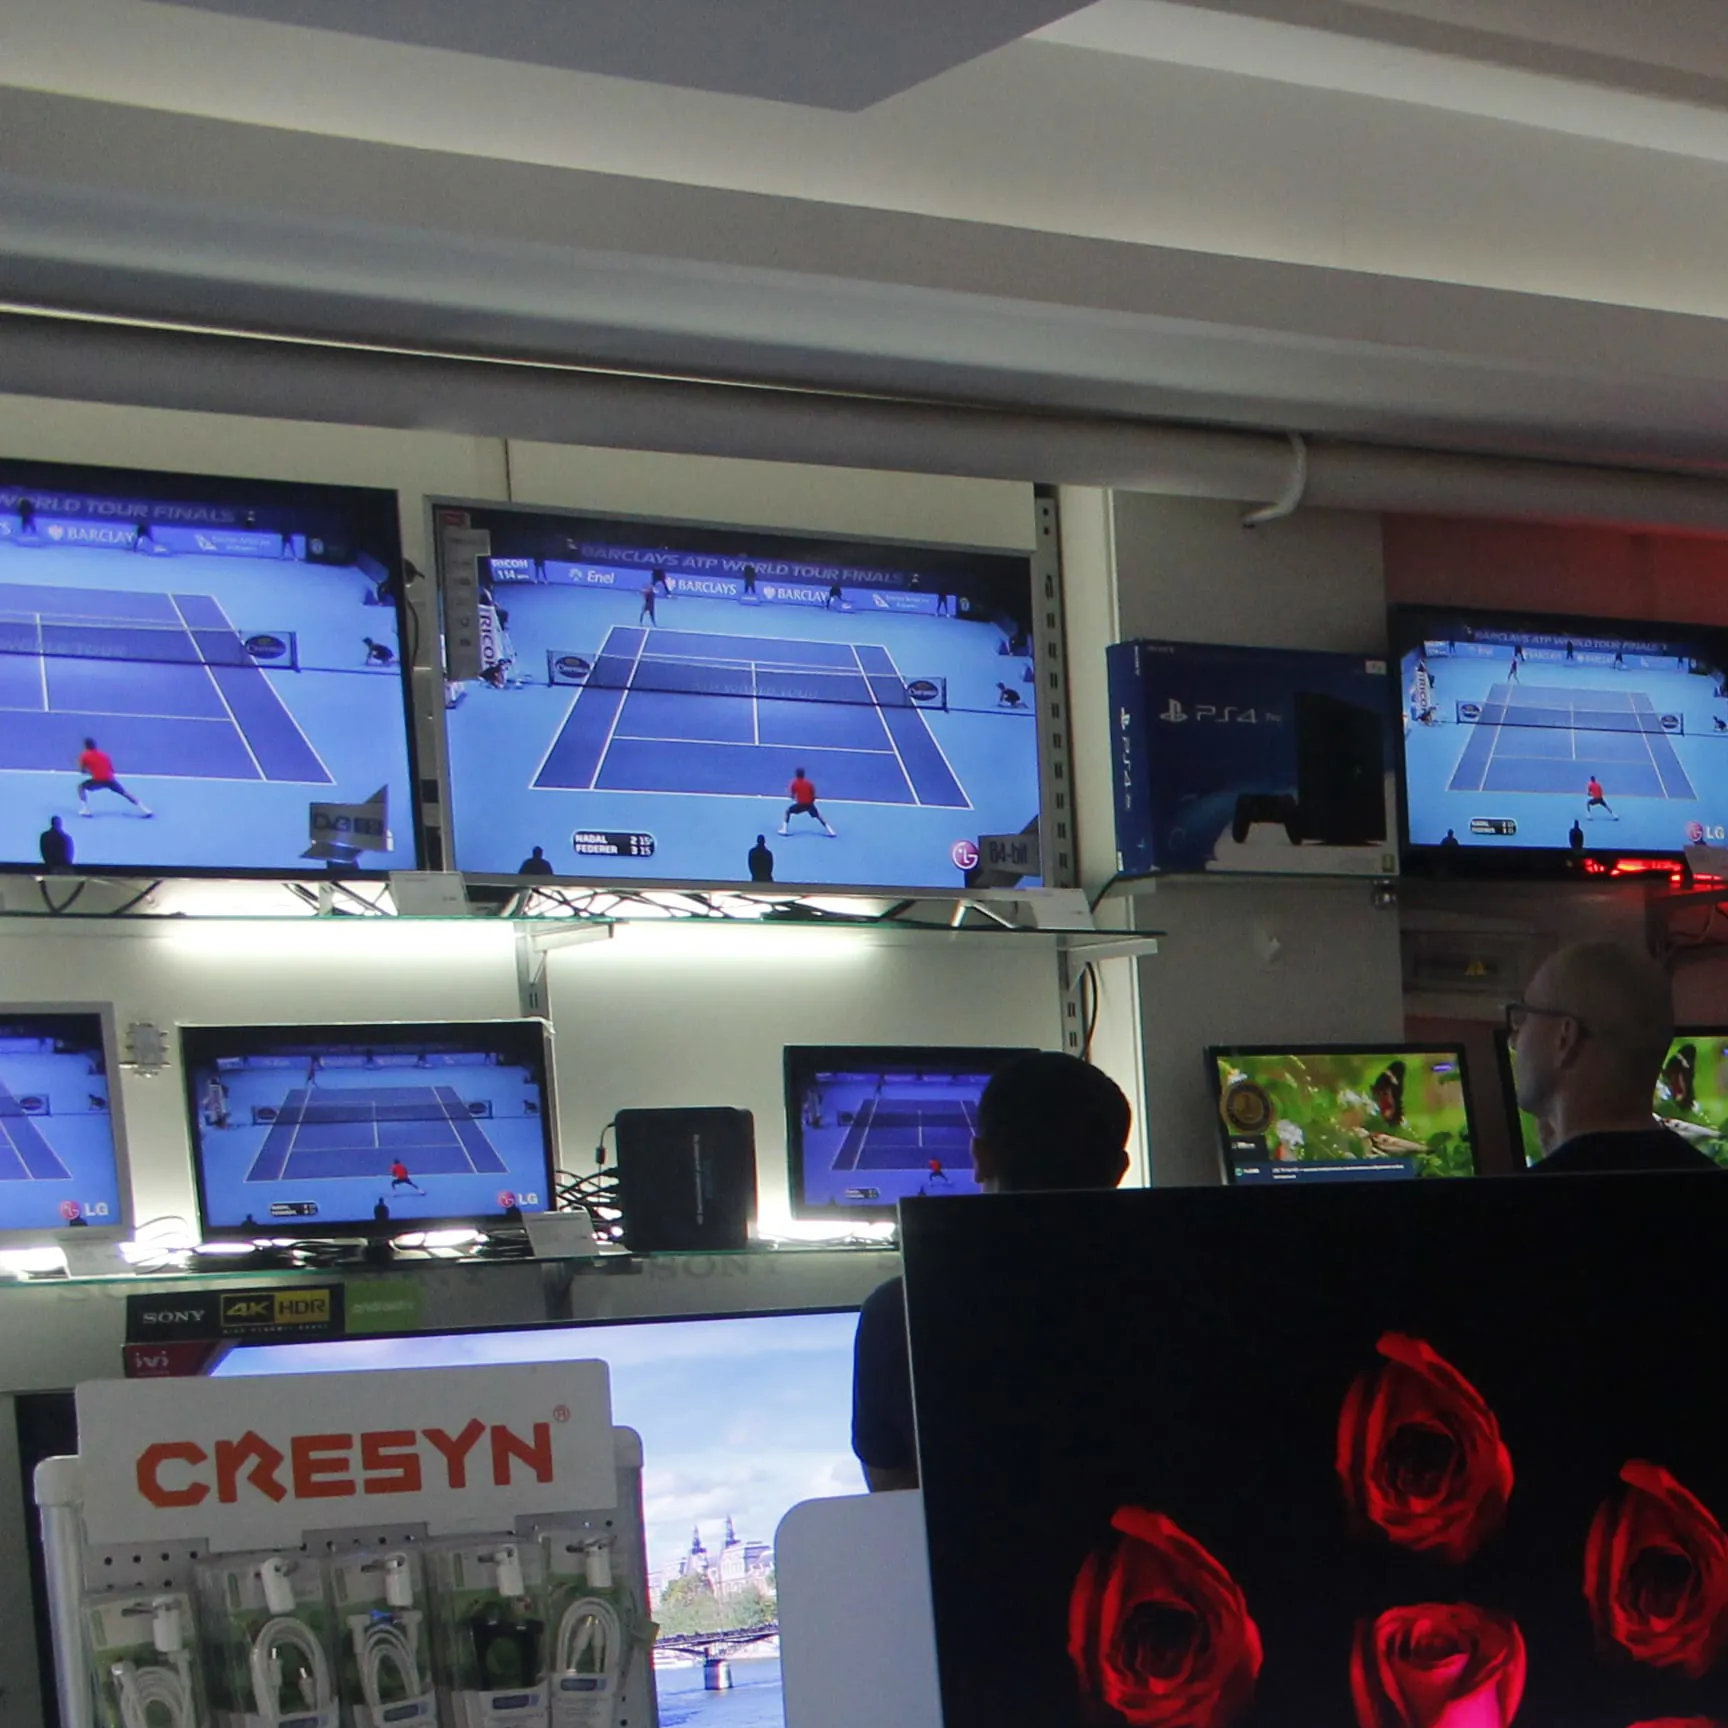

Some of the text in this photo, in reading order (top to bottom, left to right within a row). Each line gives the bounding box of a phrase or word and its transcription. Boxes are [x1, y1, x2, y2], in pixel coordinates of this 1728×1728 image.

[87, 500, 236, 523] TOUR FINALS
[66, 524, 140, 545] BARCLAY
[682, 553, 720, 570] ATP
[721, 557, 789, 577] WRLD
[793, 564, 840, 582] TOUR
[586, 570, 616, 586] Enel
[677, 578, 738, 597] BARCLAYS
[776, 587, 832, 604] BARCLAY
[1195, 704, 1258, 725] PS4
[1705, 824, 1725, 840] LG
[83, 1201, 109, 1217] LG
[516, 1193, 538, 1206] LG
[141, 1308, 206, 1326] SONY
[225, 1298, 328, 1318] 4K HDR
[136, 1417, 556, 1508] CRESYN
